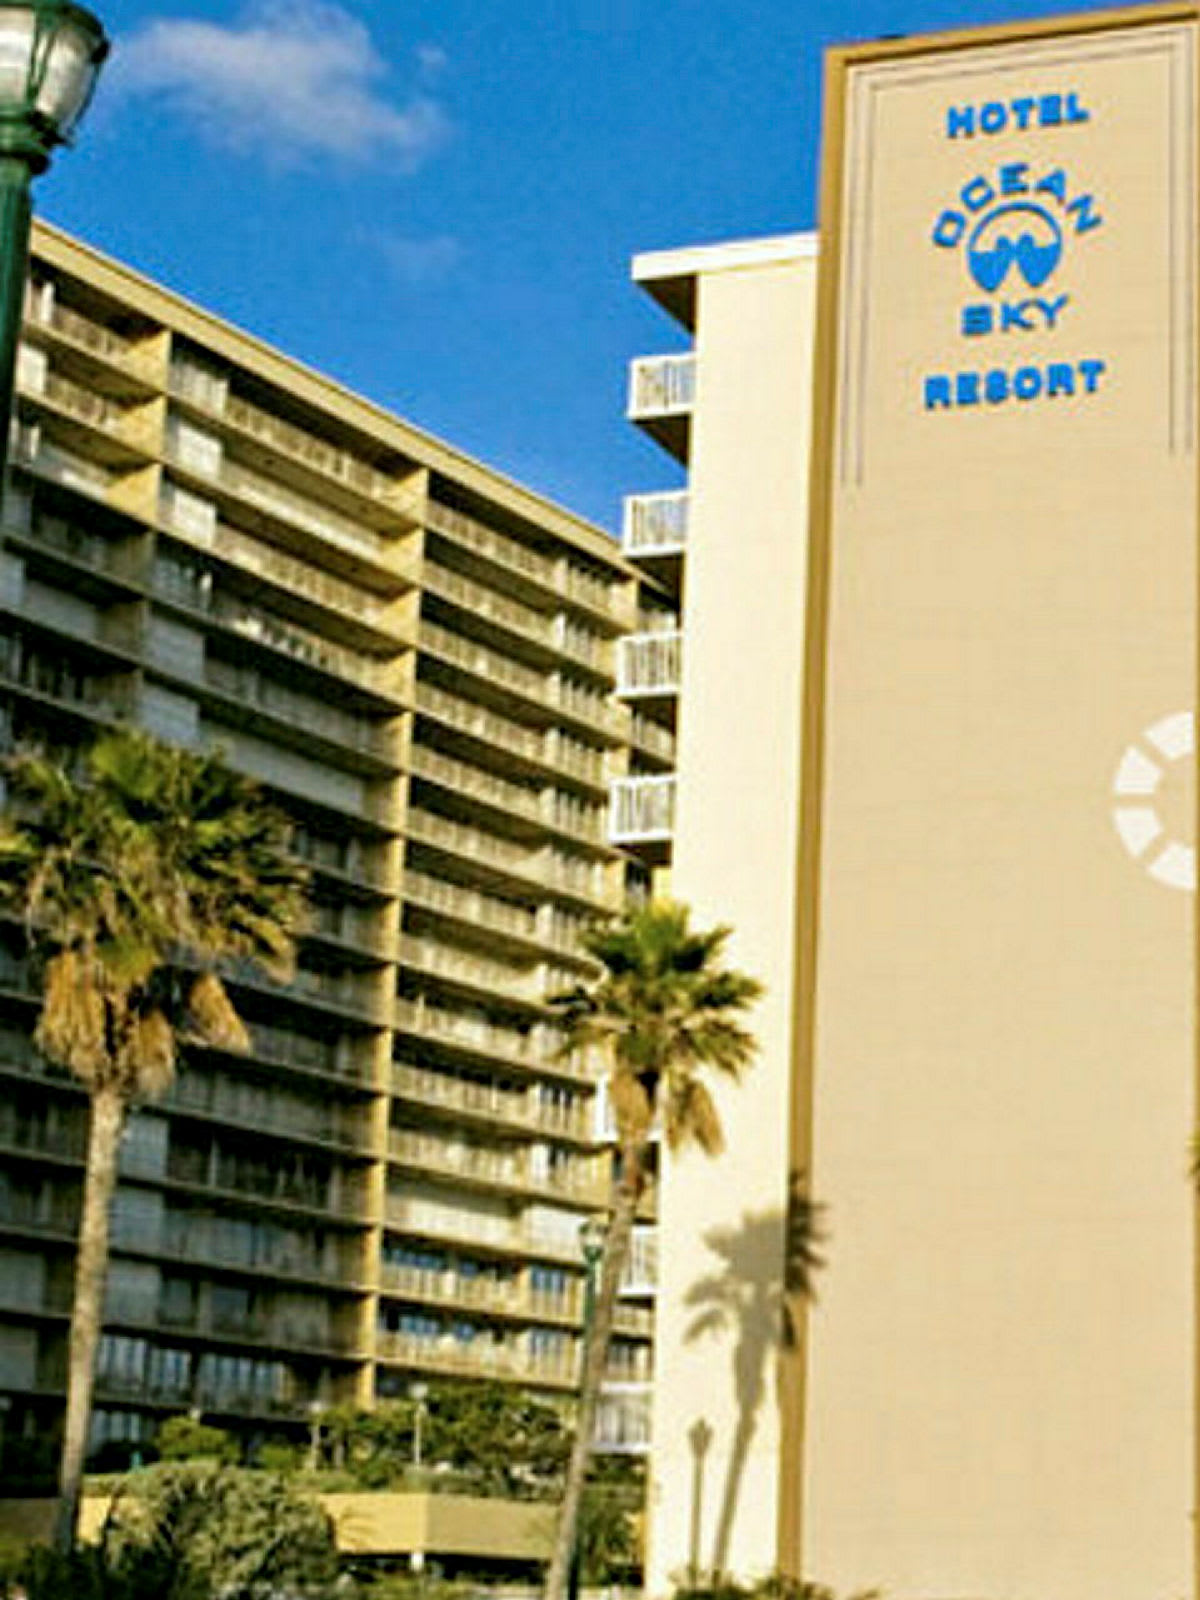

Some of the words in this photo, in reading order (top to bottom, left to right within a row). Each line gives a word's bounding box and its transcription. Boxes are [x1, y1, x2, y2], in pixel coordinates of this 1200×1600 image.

[947, 93, 1089, 138] HOTEL
[932, 163, 1102, 248] OCEAN
[962, 294, 1068, 336] SKY
[924, 359, 1105, 409] RESORT
